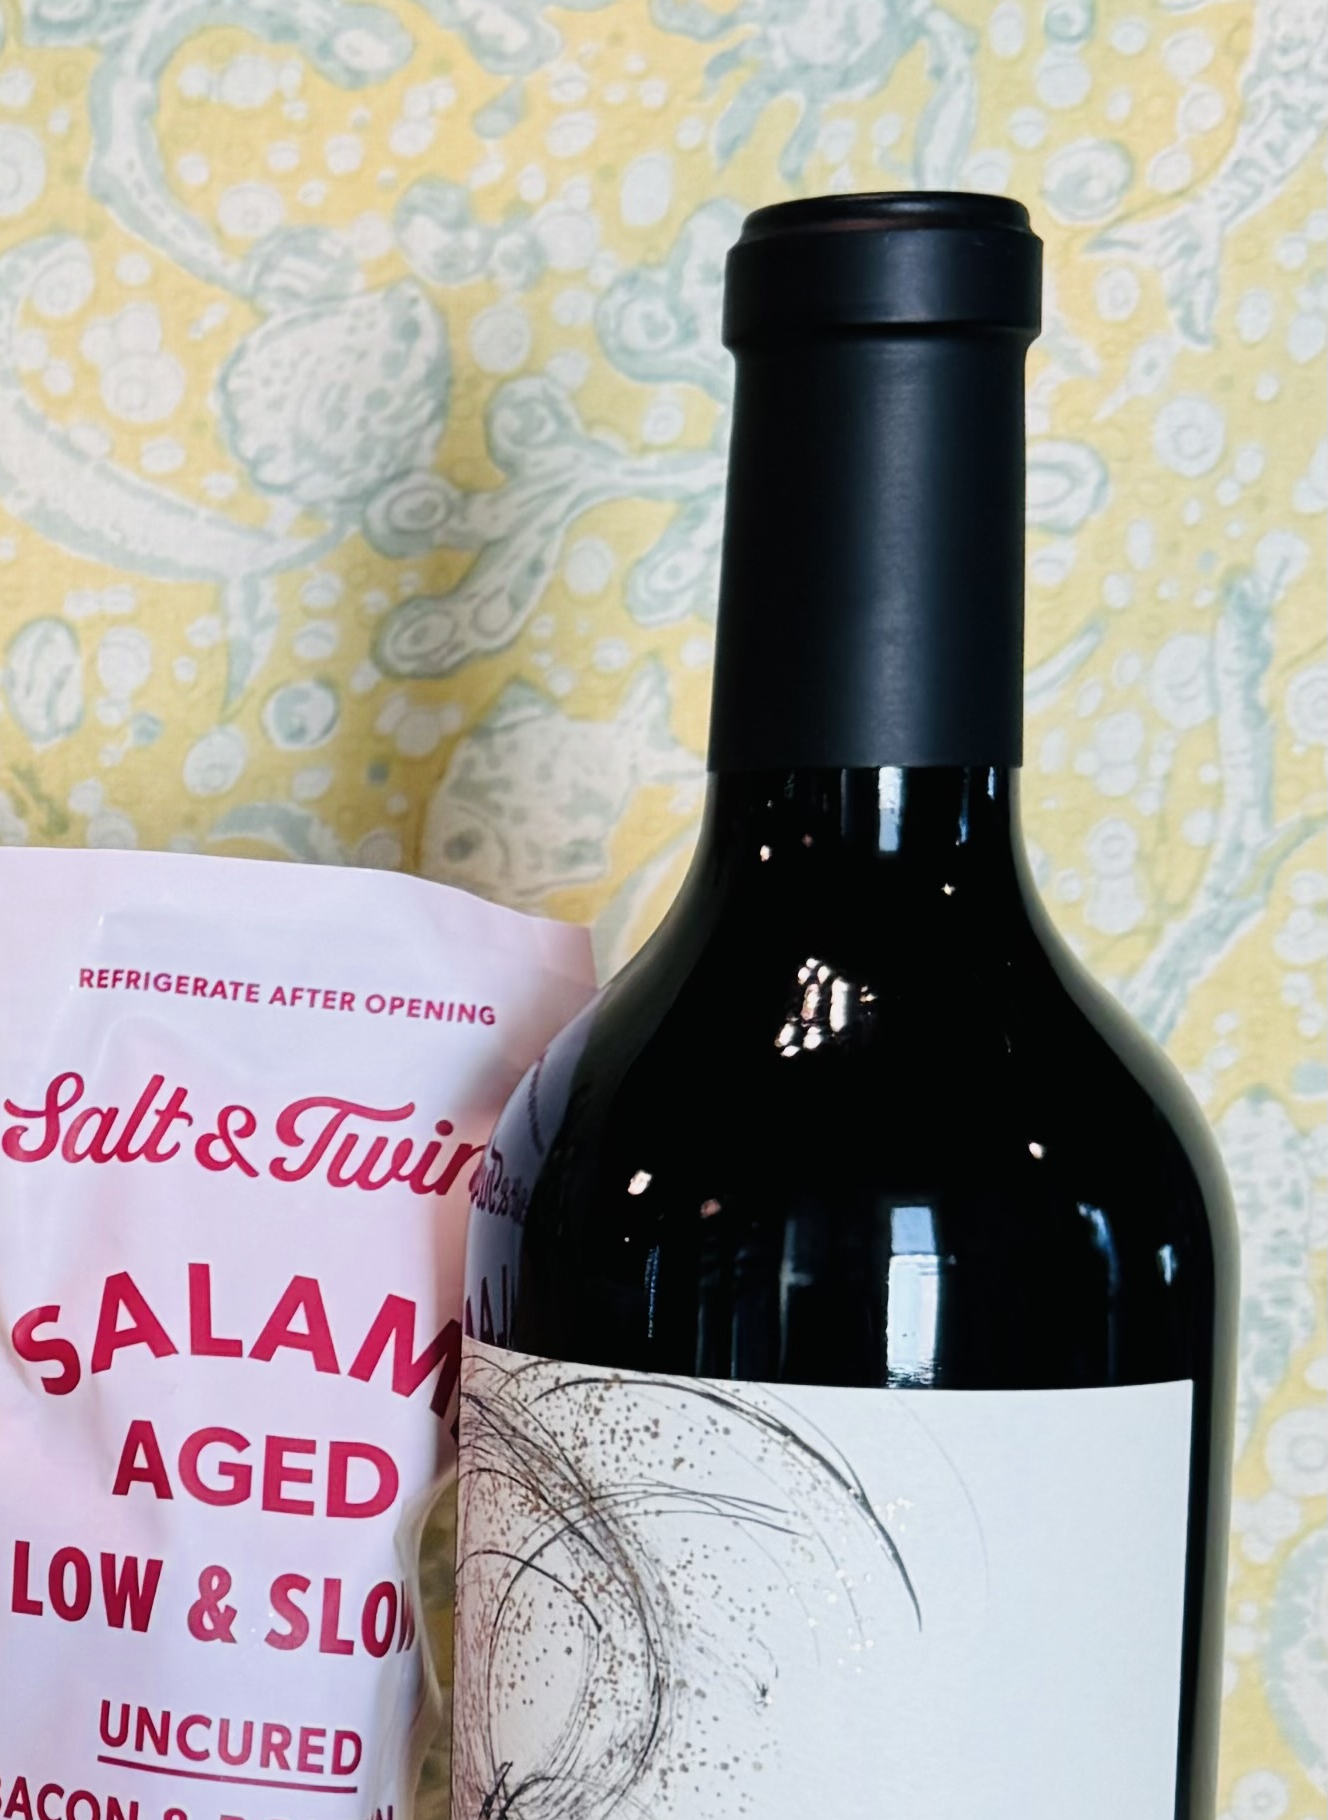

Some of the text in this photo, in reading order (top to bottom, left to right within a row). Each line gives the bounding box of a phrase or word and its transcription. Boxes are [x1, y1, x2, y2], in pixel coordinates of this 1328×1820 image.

[78, 968, 497, 1027] REFRIGERATE AFTER OPENING
[1, 1072, 488, 1196] Salt & Twin
[11, 1263, 461, 1422] SALAM
[112, 1420, 399, 1519] AGED
[11, 1540, 163, 1633] LOW
[187, 1566, 237, 1645] &
[97, 1699, 362, 1776] UNCURED
